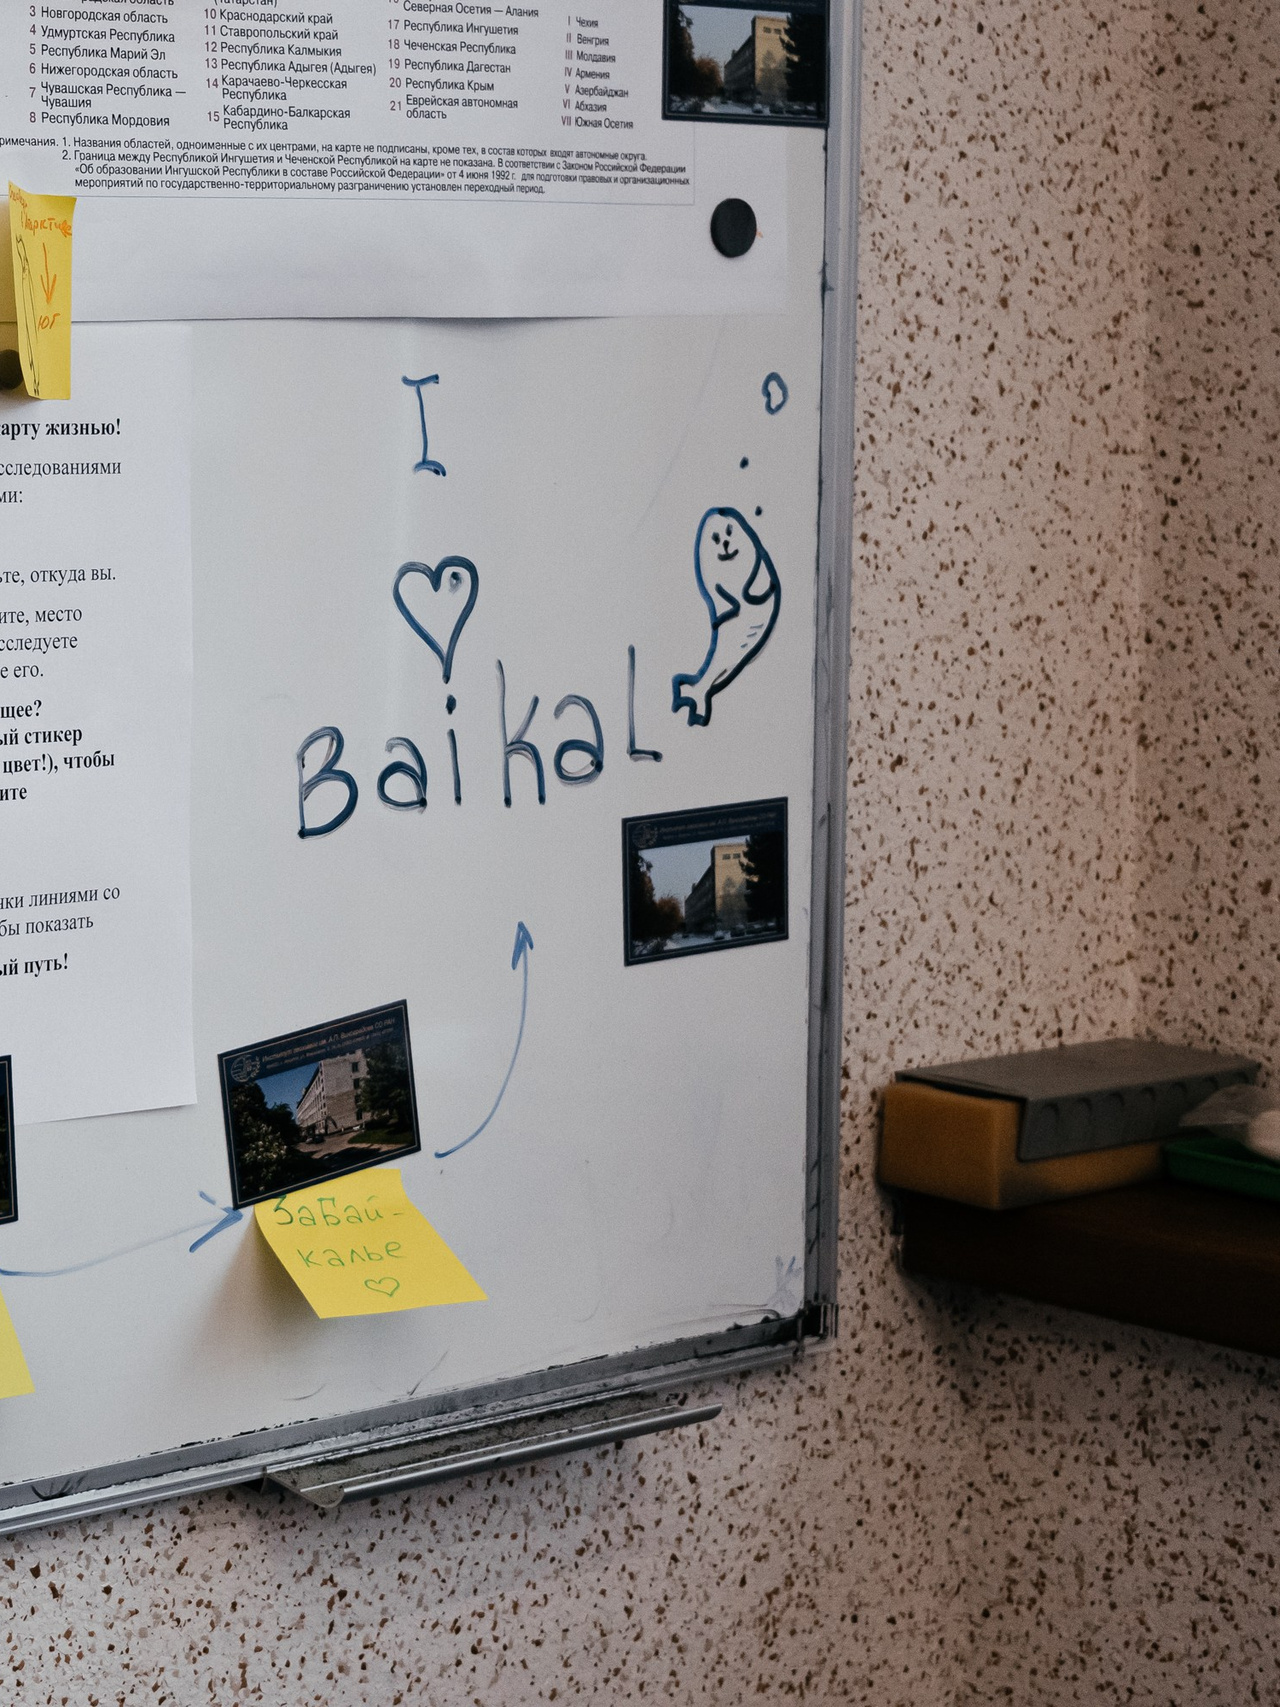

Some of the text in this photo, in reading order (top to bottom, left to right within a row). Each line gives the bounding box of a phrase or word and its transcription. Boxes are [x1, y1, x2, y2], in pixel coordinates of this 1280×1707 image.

[29, 4, 169, 24] 3 Новгородская область
[203, 8, 334, 27] 10 Краснодарский край
[29, 23, 176, 45] 4 Удмуртская Республика
[204, 24, 339, 41] 11 Ставропольский край
[29, 42, 166, 62] 5 Республика Марий Эл
[29, 62, 179, 79] 6 Нижегородская область
[45, 417, 121, 436] жизнью!
[30, 568, 86, 587] откуда
[91, 568, 116, 581] вы.
[35, 608, 83, 623] место
[13, 664, 44, 679] его.
[24, 728, 83, 747] стикер
[2, 753, 59, 776] цвет!),
[63, 750, 115, 769] чтобы
[28, 888, 99, 908] линиями
[102, 887, 121, 901] со
[25, 916, 94, 935] показать
[24, 952, 68, 978] путь!
